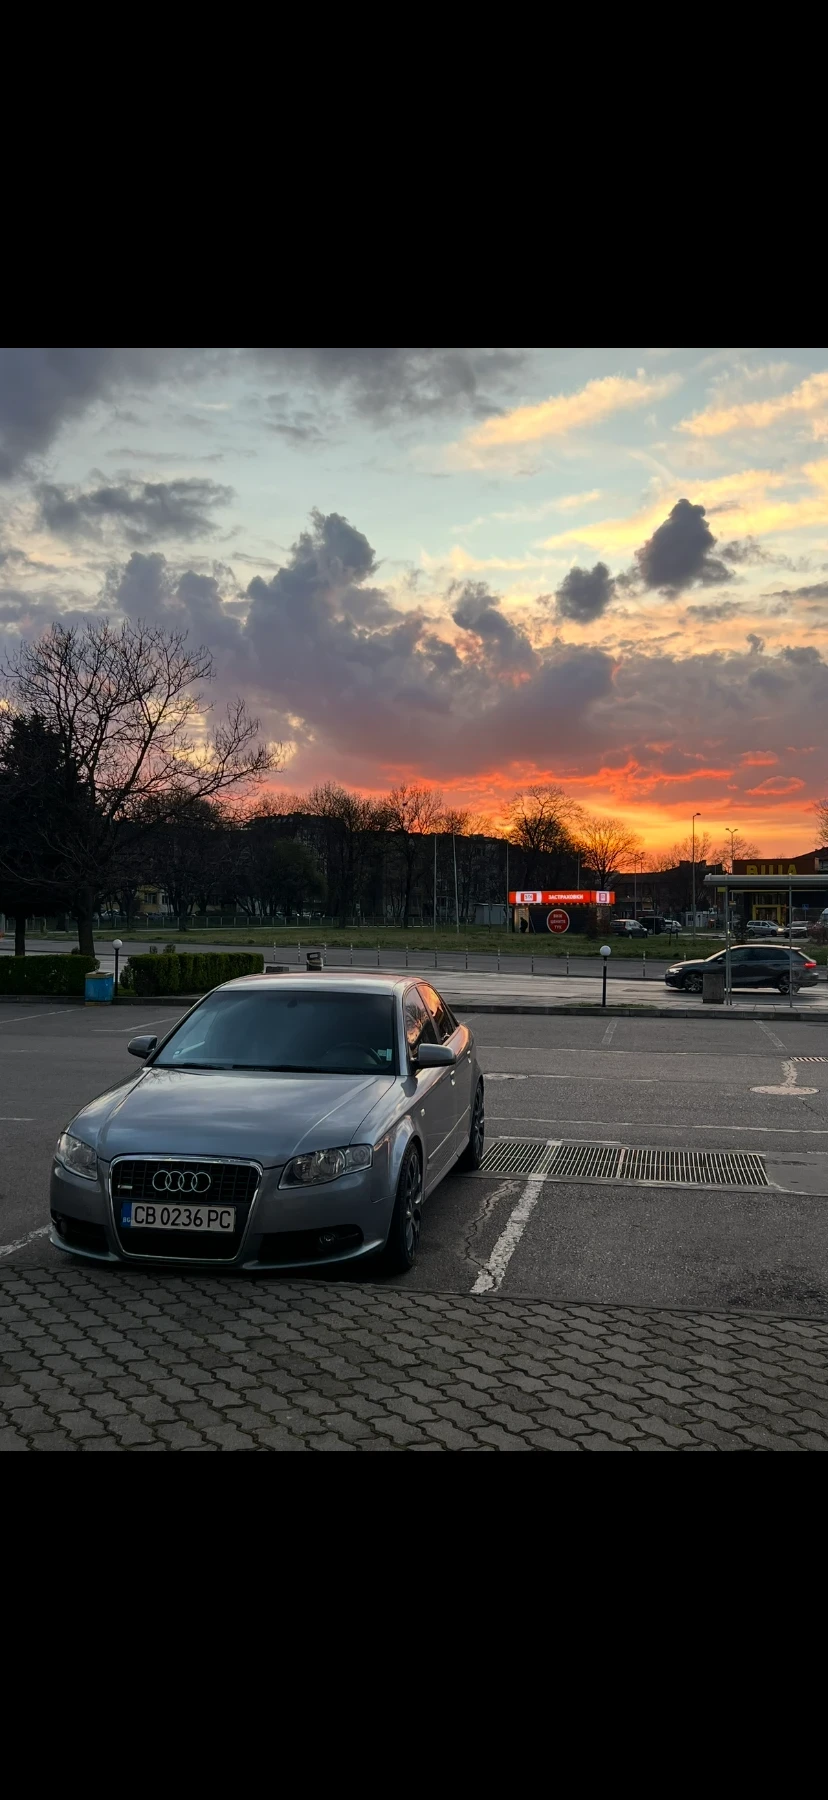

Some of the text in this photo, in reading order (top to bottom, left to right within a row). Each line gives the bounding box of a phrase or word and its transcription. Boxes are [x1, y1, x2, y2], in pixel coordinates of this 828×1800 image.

[134, 1206, 231, 1228] CB 0236 PC
